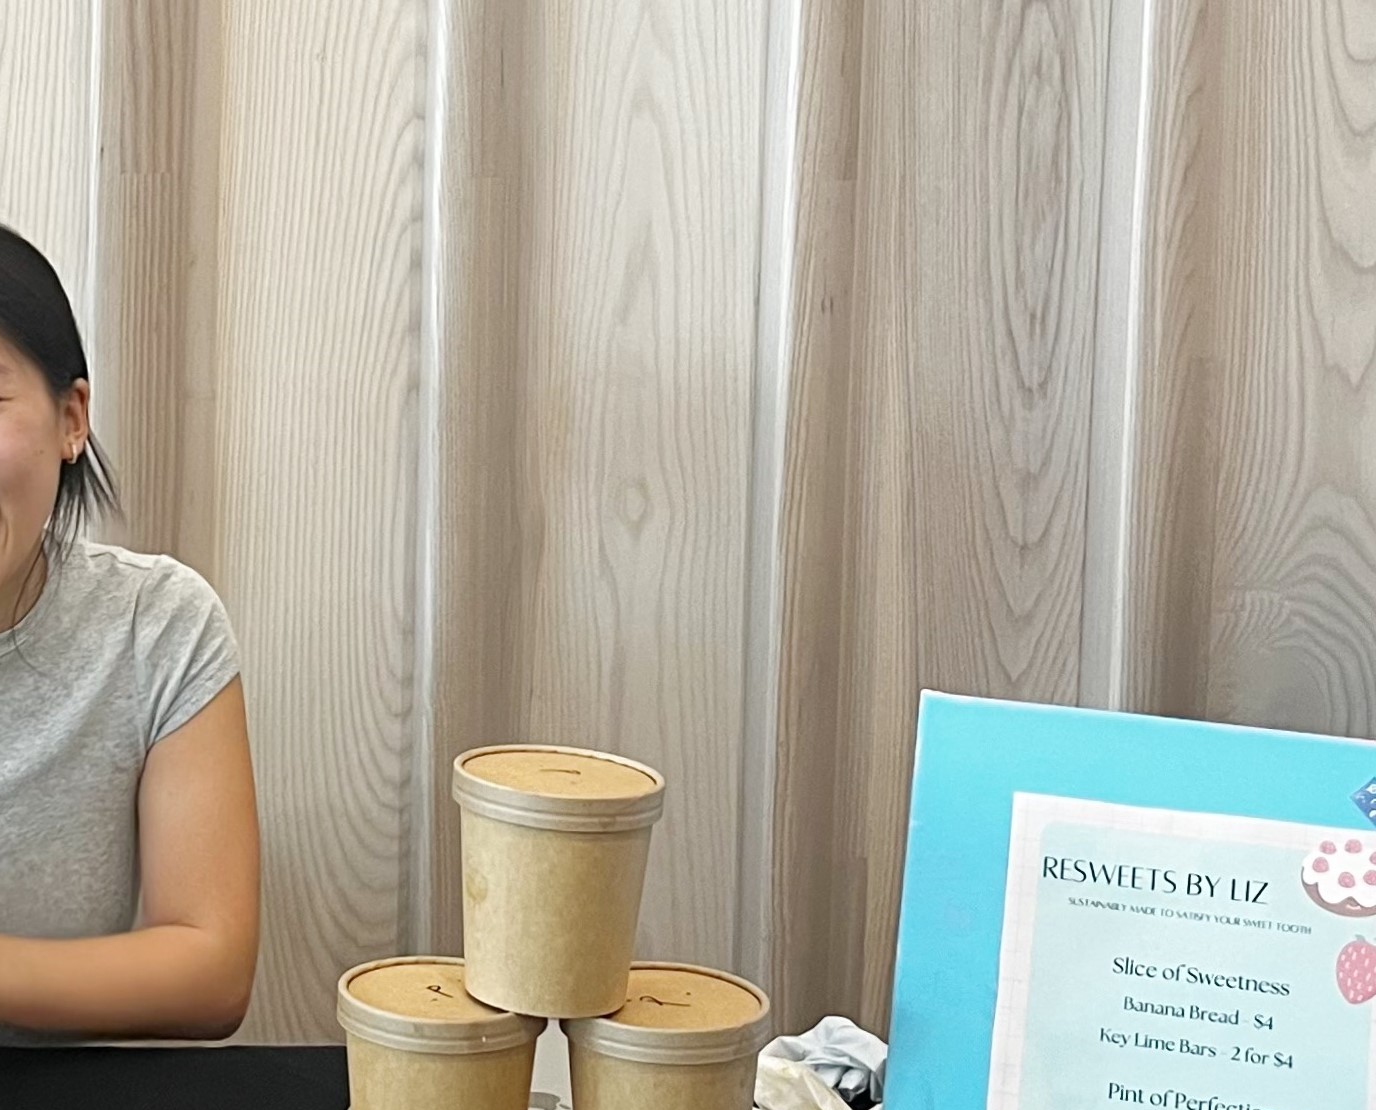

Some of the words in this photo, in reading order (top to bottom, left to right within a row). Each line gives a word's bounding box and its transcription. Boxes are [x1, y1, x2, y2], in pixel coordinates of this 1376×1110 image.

[1043, 856, 1177, 893] RESWEETS
[1187, 873, 1221, 898] BY
[1231, 879, 1269, 905] LIZ
[1160, 908, 1174, 918] TO
[1214, 914, 1241, 926] YOUR
[1277, 922, 1312, 934] TOOTH
[1112, 957, 1157, 981] Slice
[1162, 963, 1186, 982] of
[1187, 967, 1291, 996] Sweetness
[1124, 997, 1185, 1019] Banana
[1189, 1005, 1239, 1026] Bread
[1253, 1014, 1274, 1031] $4
[1100, 1028, 1131, 1048] Key
[1134, 1033, 1175, 1052] Lime
[1179, 1039, 1217, 1058] Bars
[1230, 1047, 1241, 1062] 2
[1244, 1049, 1269, 1067] for
[1273, 1052, 1294, 1069] $4
[1108, 1082, 1144, 1104] Pint
[1150, 1089, 1173, 1107] of
